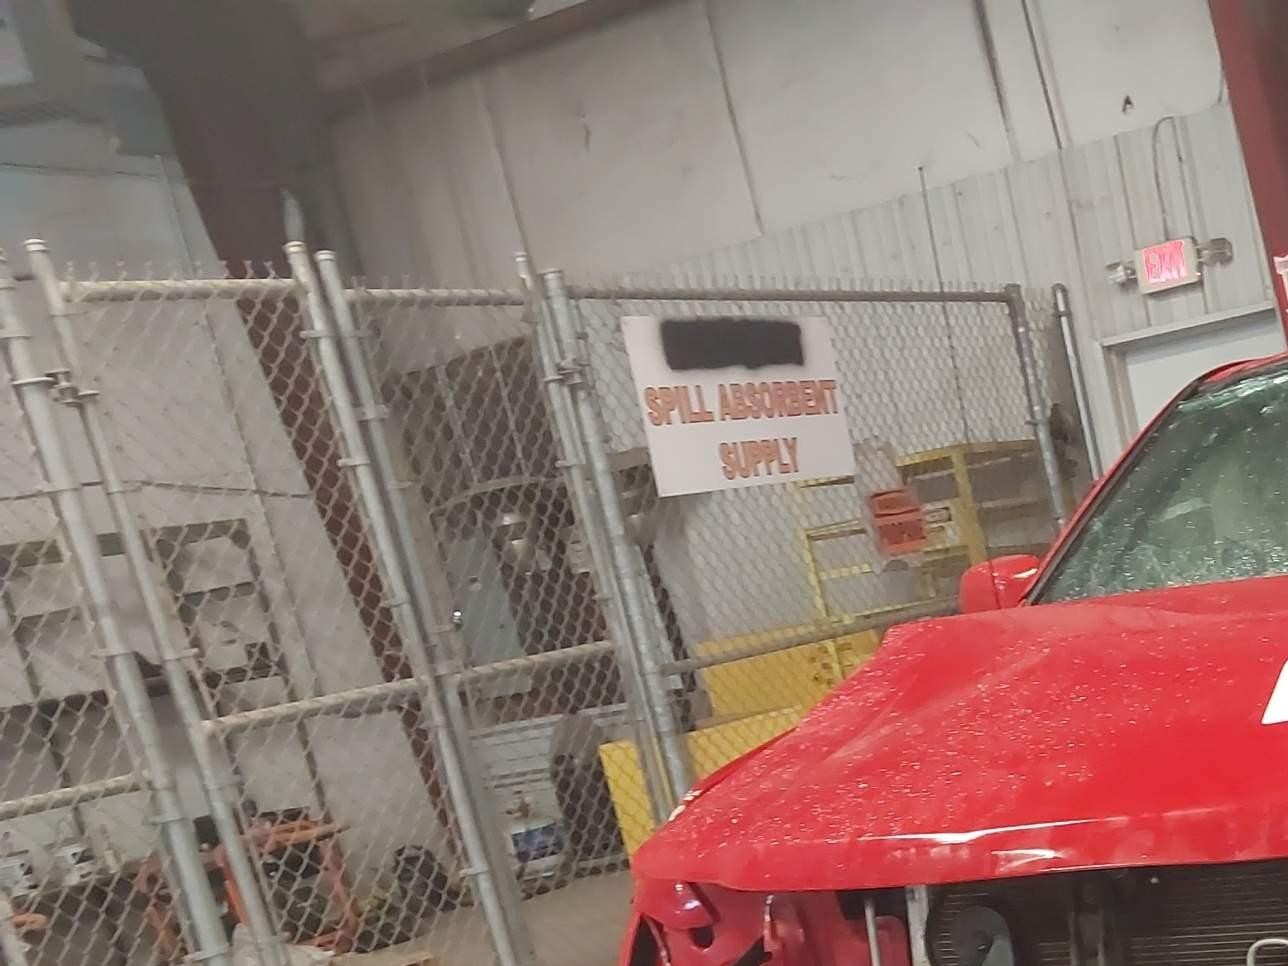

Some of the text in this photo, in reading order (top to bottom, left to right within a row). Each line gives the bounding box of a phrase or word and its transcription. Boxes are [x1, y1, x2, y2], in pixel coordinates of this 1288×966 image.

[644, 379, 839, 426] SPILL ABSORBENT
[719, 436, 800, 480] SUPPLY
